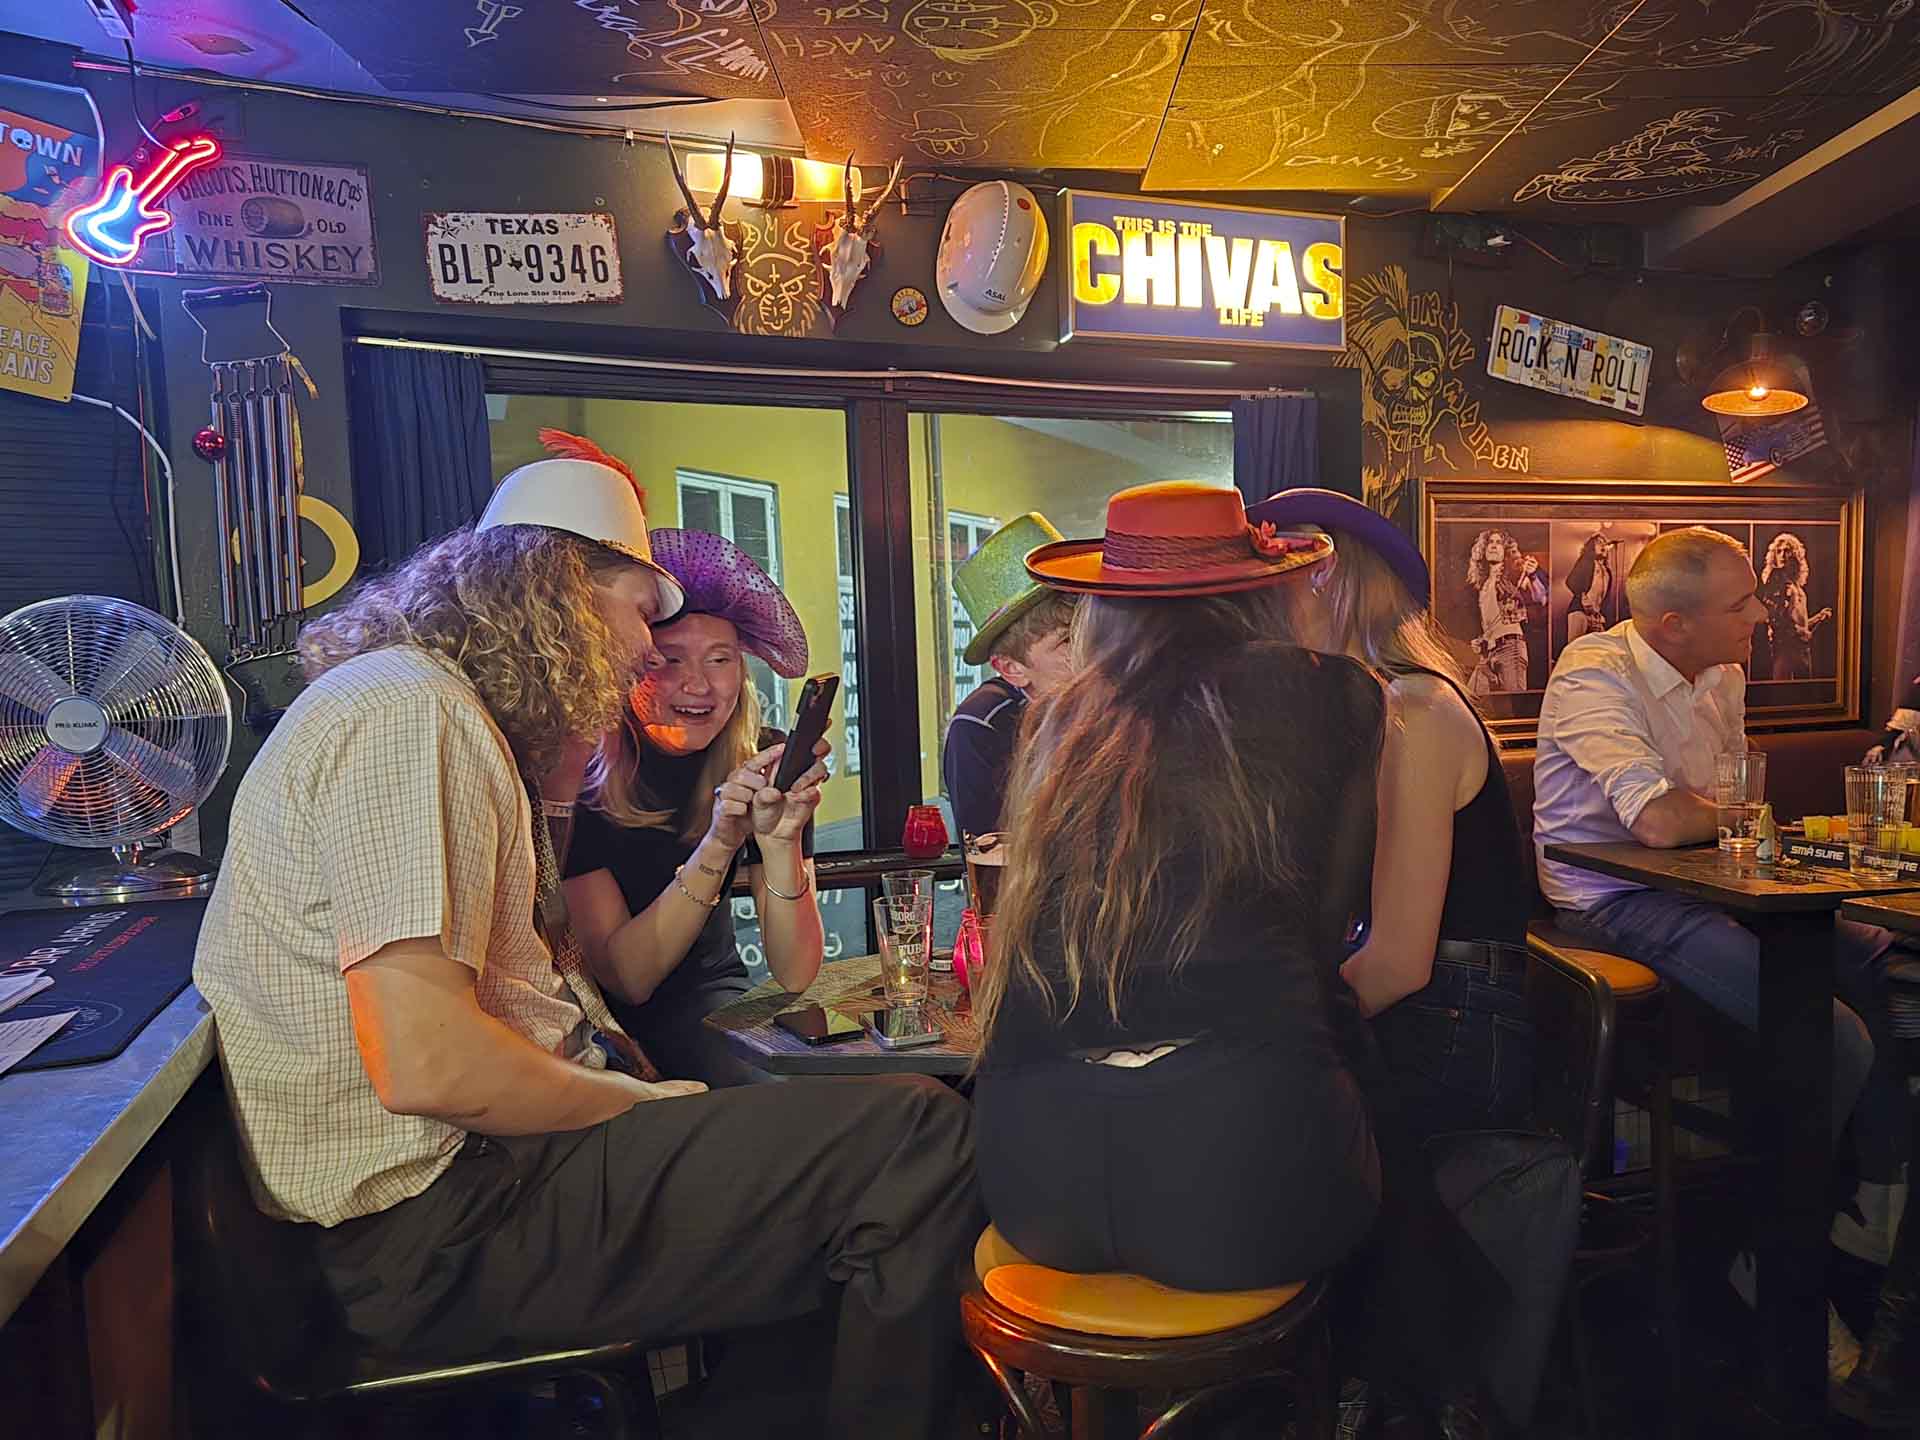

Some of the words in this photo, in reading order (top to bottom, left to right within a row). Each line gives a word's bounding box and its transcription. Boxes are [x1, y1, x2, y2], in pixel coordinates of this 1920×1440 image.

[198, 210, 234, 227] FINE
[317, 218, 346, 234] OLD
[485, 218, 560, 235] TEXAS
[1113, 215, 1154, 233] THIS
[1157, 219, 1177, 234] IS
[1180, 221, 1214, 238] THE
[185, 234, 363, 273] WHISKEY
[438, 243, 502, 285] BLP
[524, 243, 610, 284] 9346
[1071, 222, 1343, 320] CHIVAS
[552, 289, 576, 297] State
[1218, 307, 1264, 328] LIFE
[0, 352, 53, 384] ANS
[1497, 327, 1552, 370] ROCK
[1564, 347, 1579, 381] N
[1590, 353, 1641, 396] ROLL
